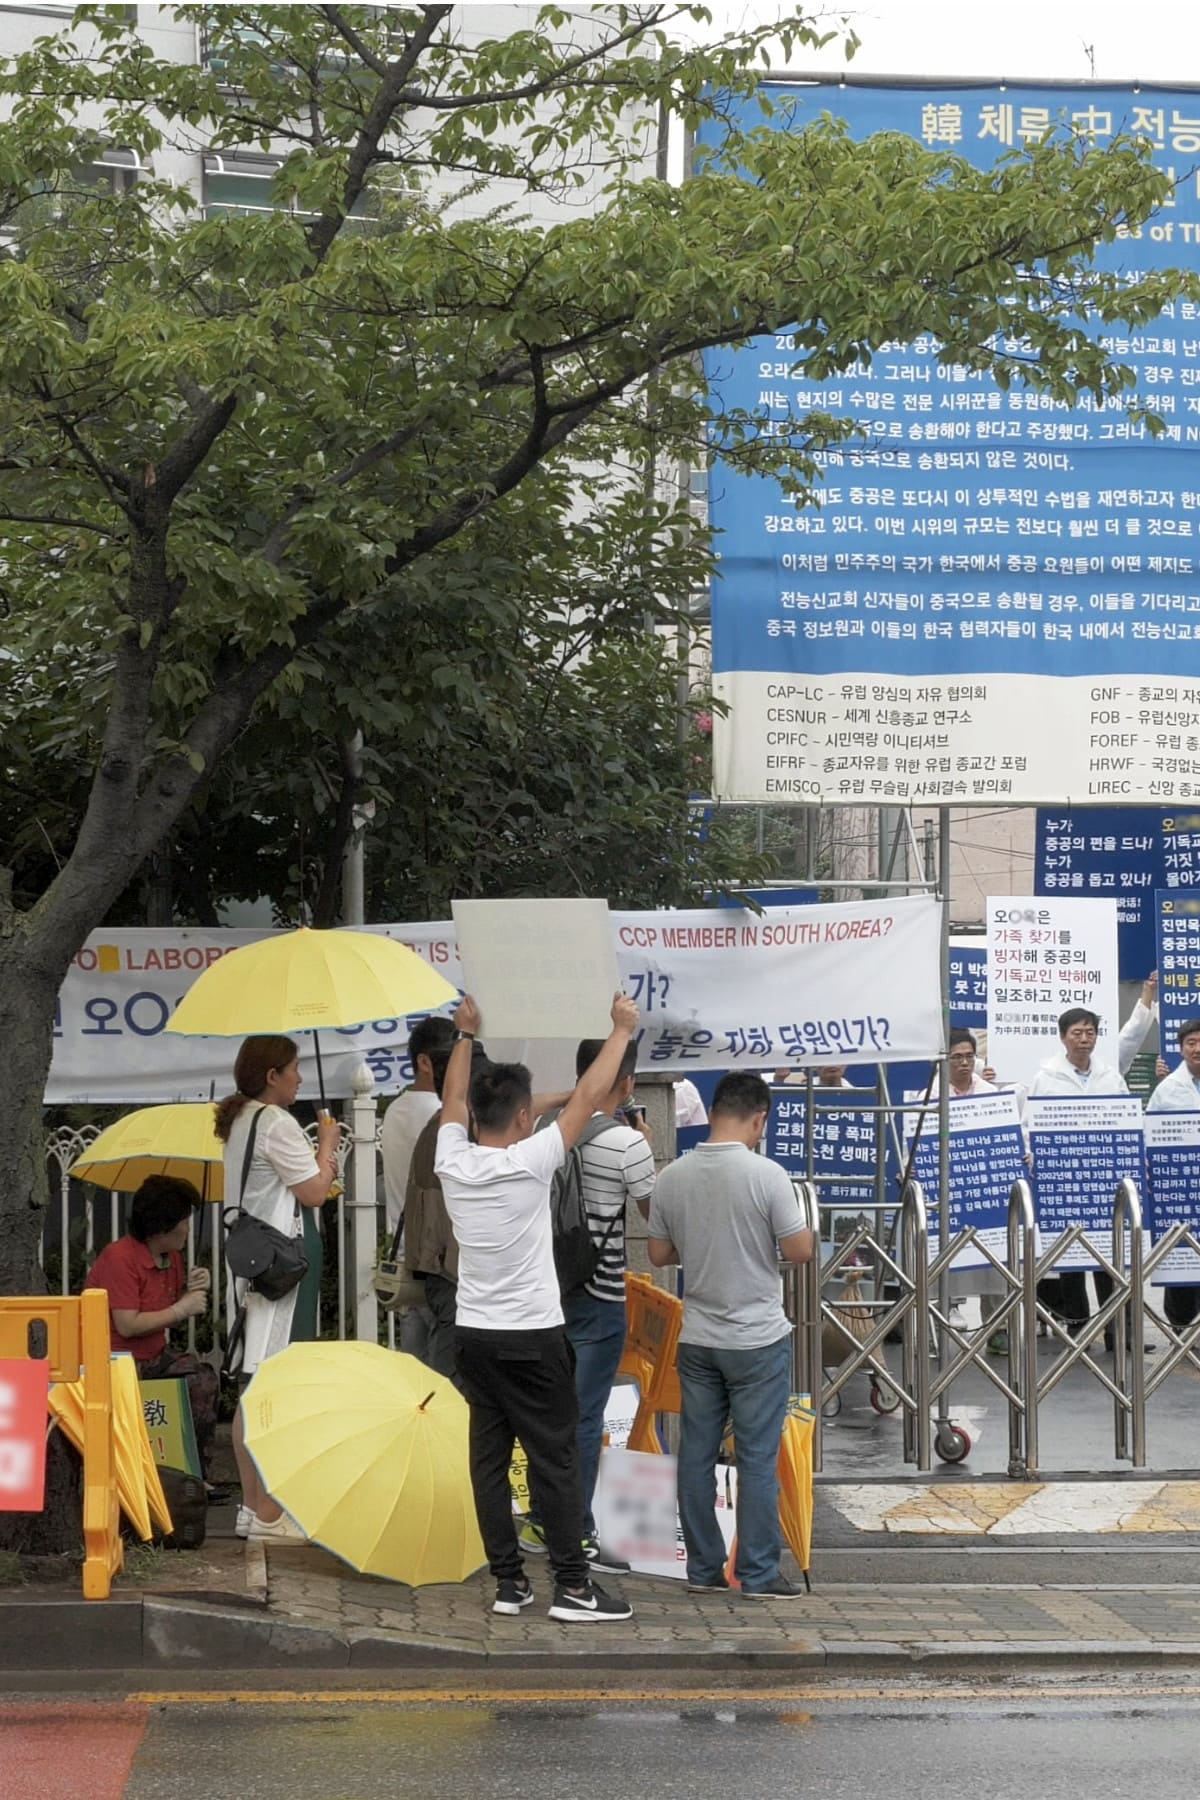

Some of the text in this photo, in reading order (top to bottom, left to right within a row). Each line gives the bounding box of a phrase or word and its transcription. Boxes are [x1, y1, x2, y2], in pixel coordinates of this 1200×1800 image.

[922, 103, 962, 145] 韓
[977, 104, 1052, 145] 체류
[1072, 105, 1111, 146] 中
[1150, 222, 1173, 242] of
[767, 619, 797, 637] 중국
[803, 620, 865, 639] 정보원과
[871, 621, 916, 640] 이들의
[923, 622, 953, 639] 한국
[960, 620, 1036, 639] 협력자들이
[1043, 623, 1073, 640] 한국
[1080, 622, 1124, 640] 내에서
[768, 685, 986, 703] CAP-LC 유럽 양심의 자유 협의회
[1091, 688, 1120, 701] GNF
[1138, 687, 1177, 703] 종교의
[1046, 819, 1073, 832] 누가
[1045, 837, 1153, 851] 중공의 편을 드나!
[1044, 855, 1072, 869] 누가
[1044, 873, 1151, 887] 중공을 돕고 있나!
[619, 917, 893, 948] CCP MEMBER IN SOUTH KOREA?
[994, 929, 1072, 945] 가족 찾기를
[1162, 937, 1200, 951] 중공의
[994, 949, 1087, 964] 빙자해 중공의
[994, 969, 1101, 984] 기독교인 박해에
[1163, 974, 1189, 987] 비밀
[994, 988, 1092, 1003] 일조하고 있다!
[650, 1016, 890, 1060] 놓은 지하 당원인가?
[775, 1122, 805, 1138] 교회
[845, 1126, 875, 1142] 폭파
